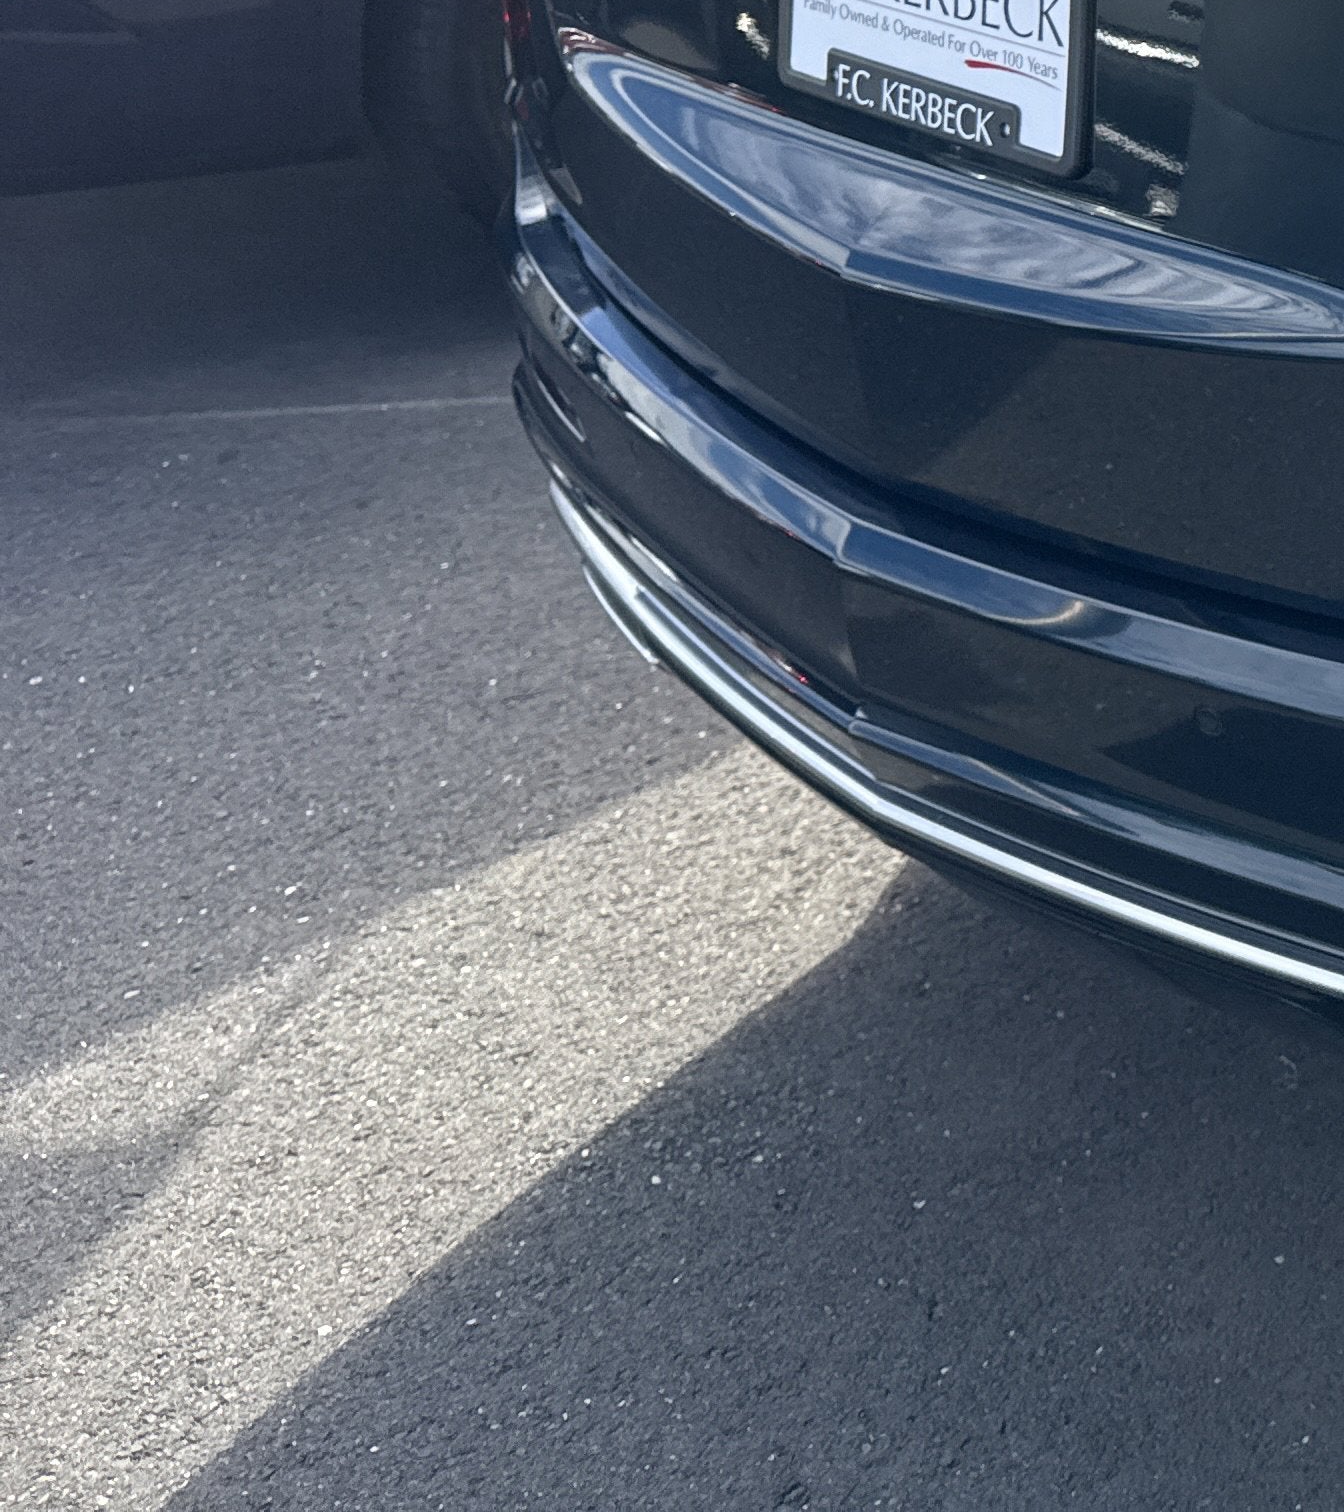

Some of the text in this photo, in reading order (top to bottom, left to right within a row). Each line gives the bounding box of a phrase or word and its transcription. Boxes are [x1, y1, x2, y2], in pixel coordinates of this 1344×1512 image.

[839, 3, 878, 29] Owned
[881, 15, 890, 32] &
[893, 18, 945, 48] Operated
[947, 33, 966, 54] For
[969, 39, 998, 62] Over
[1002, 49, 1024, 69] 100
[1027, 55, 1058, 80] Years
[836, 63, 995, 147] F.C. KERBECK
